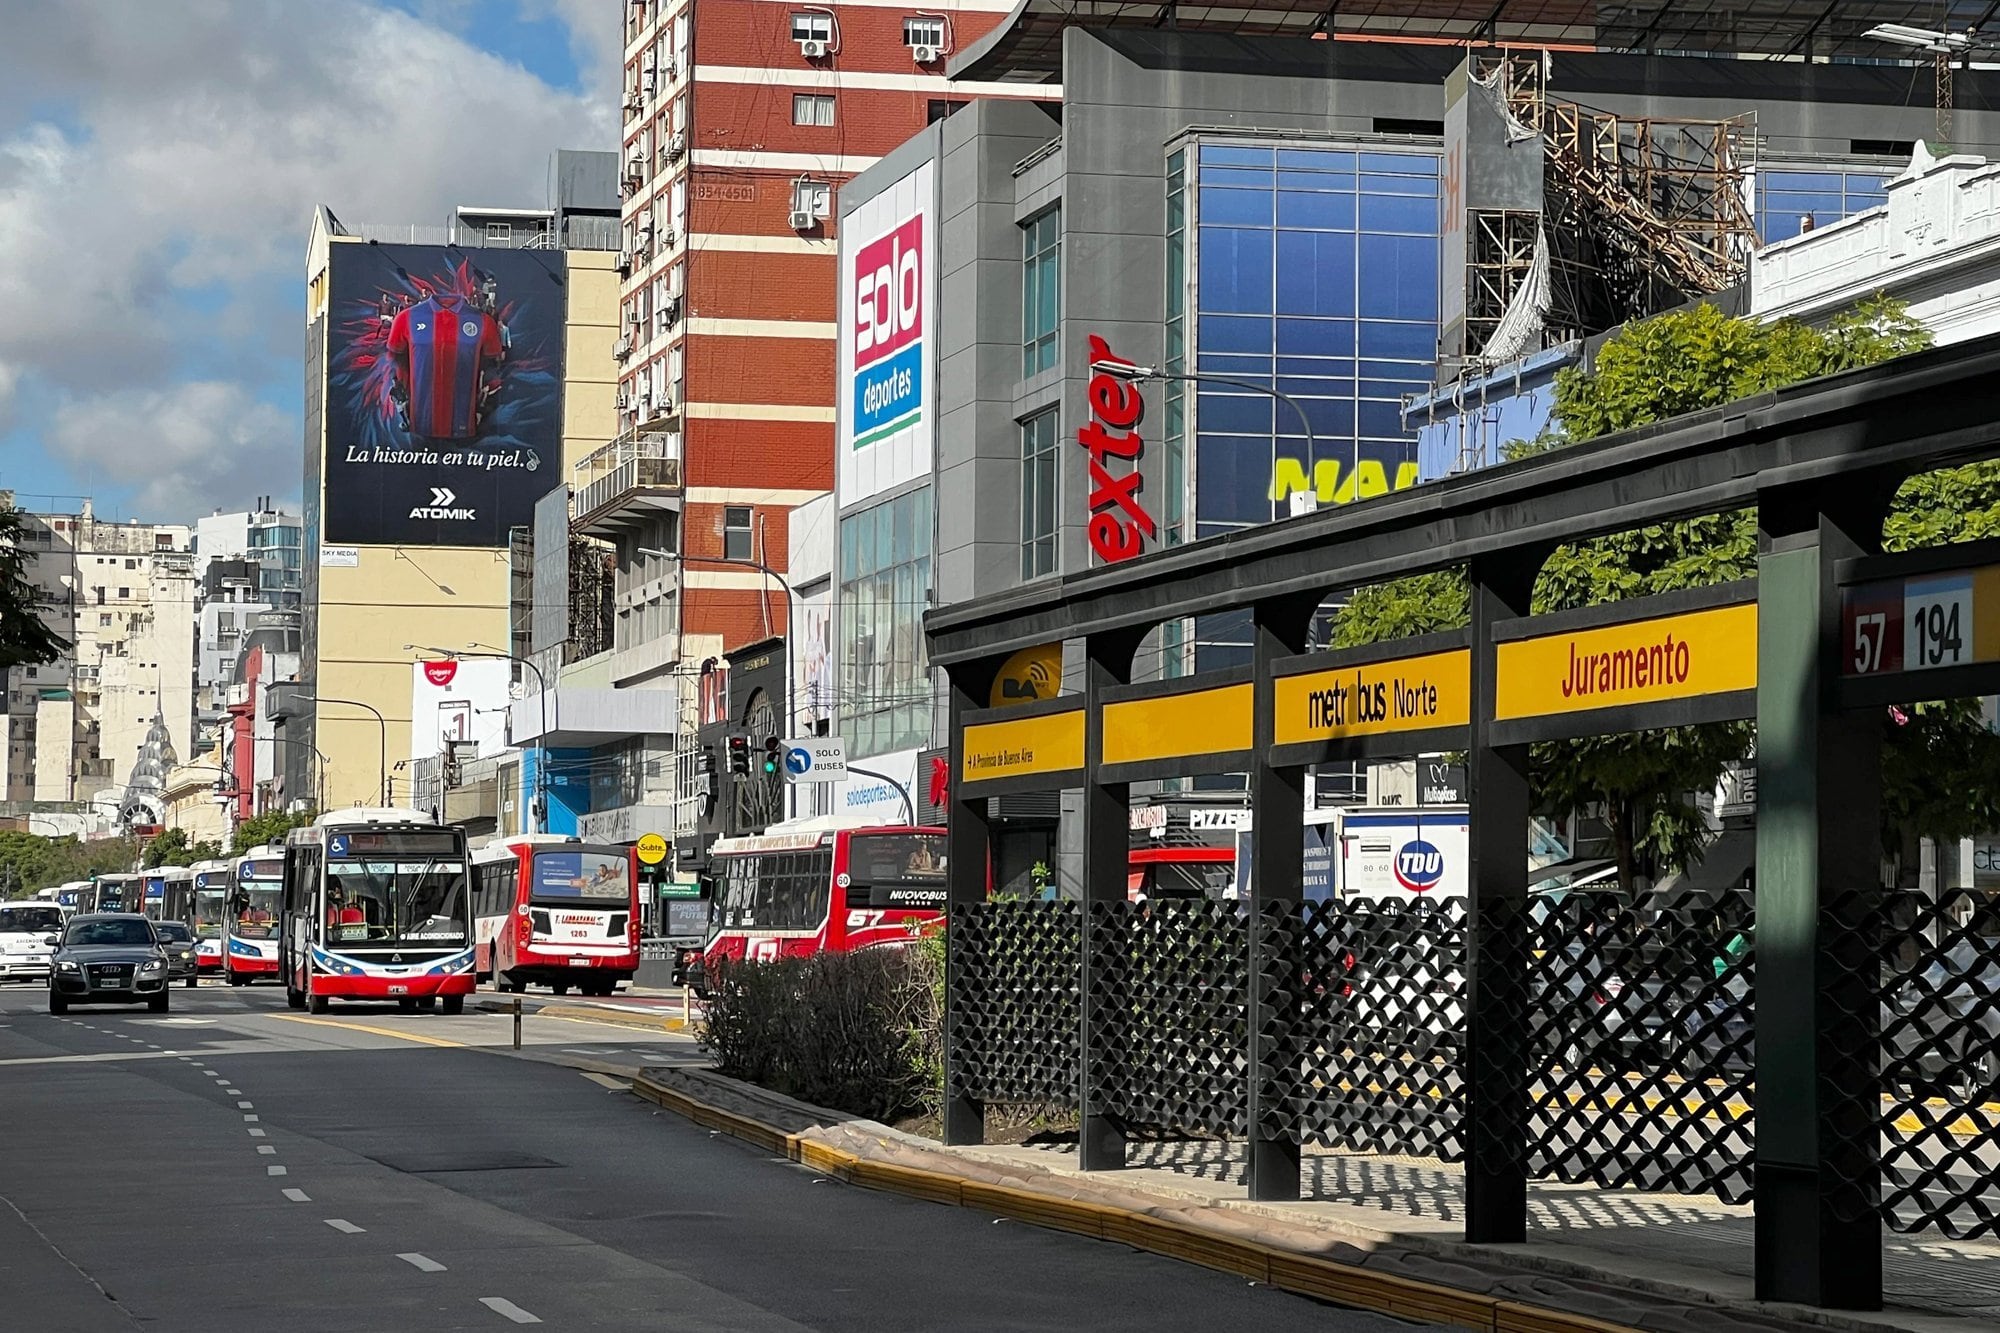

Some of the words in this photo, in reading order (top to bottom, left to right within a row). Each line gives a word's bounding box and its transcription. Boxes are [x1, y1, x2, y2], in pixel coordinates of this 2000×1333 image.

[857, 236, 919, 355] solo
[863, 367, 911, 418] deportes
[345, 445, 368, 463] La
[373, 446, 438, 465] historia
[442, 453, 459, 466] en
[466, 451, 483, 467] tu
[486, 450, 525, 471] piel.
[409, 507, 477, 521] ATOMIK
[1855, 612, 1886, 673] 57
[1914, 602, 1962, 666] 194
[1562, 632, 1690, 698] Juramento
[1309, 670, 1387, 729] metrobus
[1394, 678, 1438, 719] Norte
[815, 748, 841, 758] SOLO
[977, 752, 997, 768] Provincia
[997, 751, 1003, 766] de
[1003, 749, 1021, 765] Buenos
[1021, 747, 1033, 763] Aires
[814, 761, 844, 771] BUSES
[1363, 864, 1374, 872] 80
[1378, 864, 1389, 872] 60
[1400, 852, 1440, 874] TDU
[889, 891, 948, 900] NUOVOBUS
